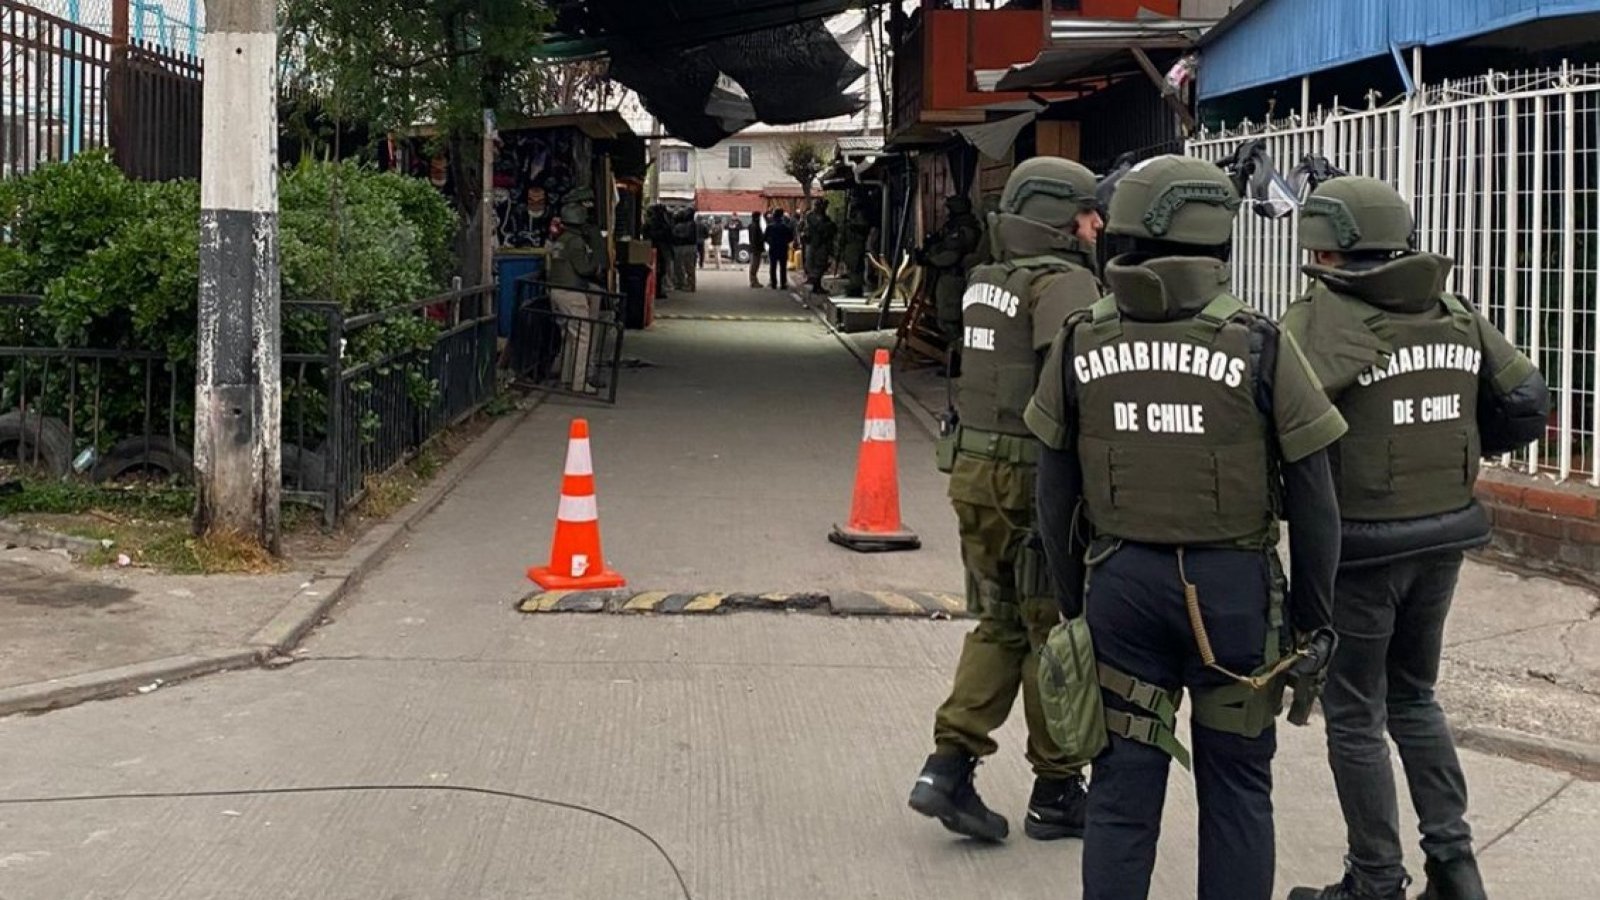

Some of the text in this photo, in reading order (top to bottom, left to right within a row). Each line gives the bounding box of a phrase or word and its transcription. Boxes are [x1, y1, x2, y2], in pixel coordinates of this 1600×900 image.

[972, 327, 995, 351] CHILE
[1073, 341, 1246, 388] CARABINEROS
[1113, 402, 1205, 434] DE CHILE
[1392, 393, 1461, 425] DE CHILE
